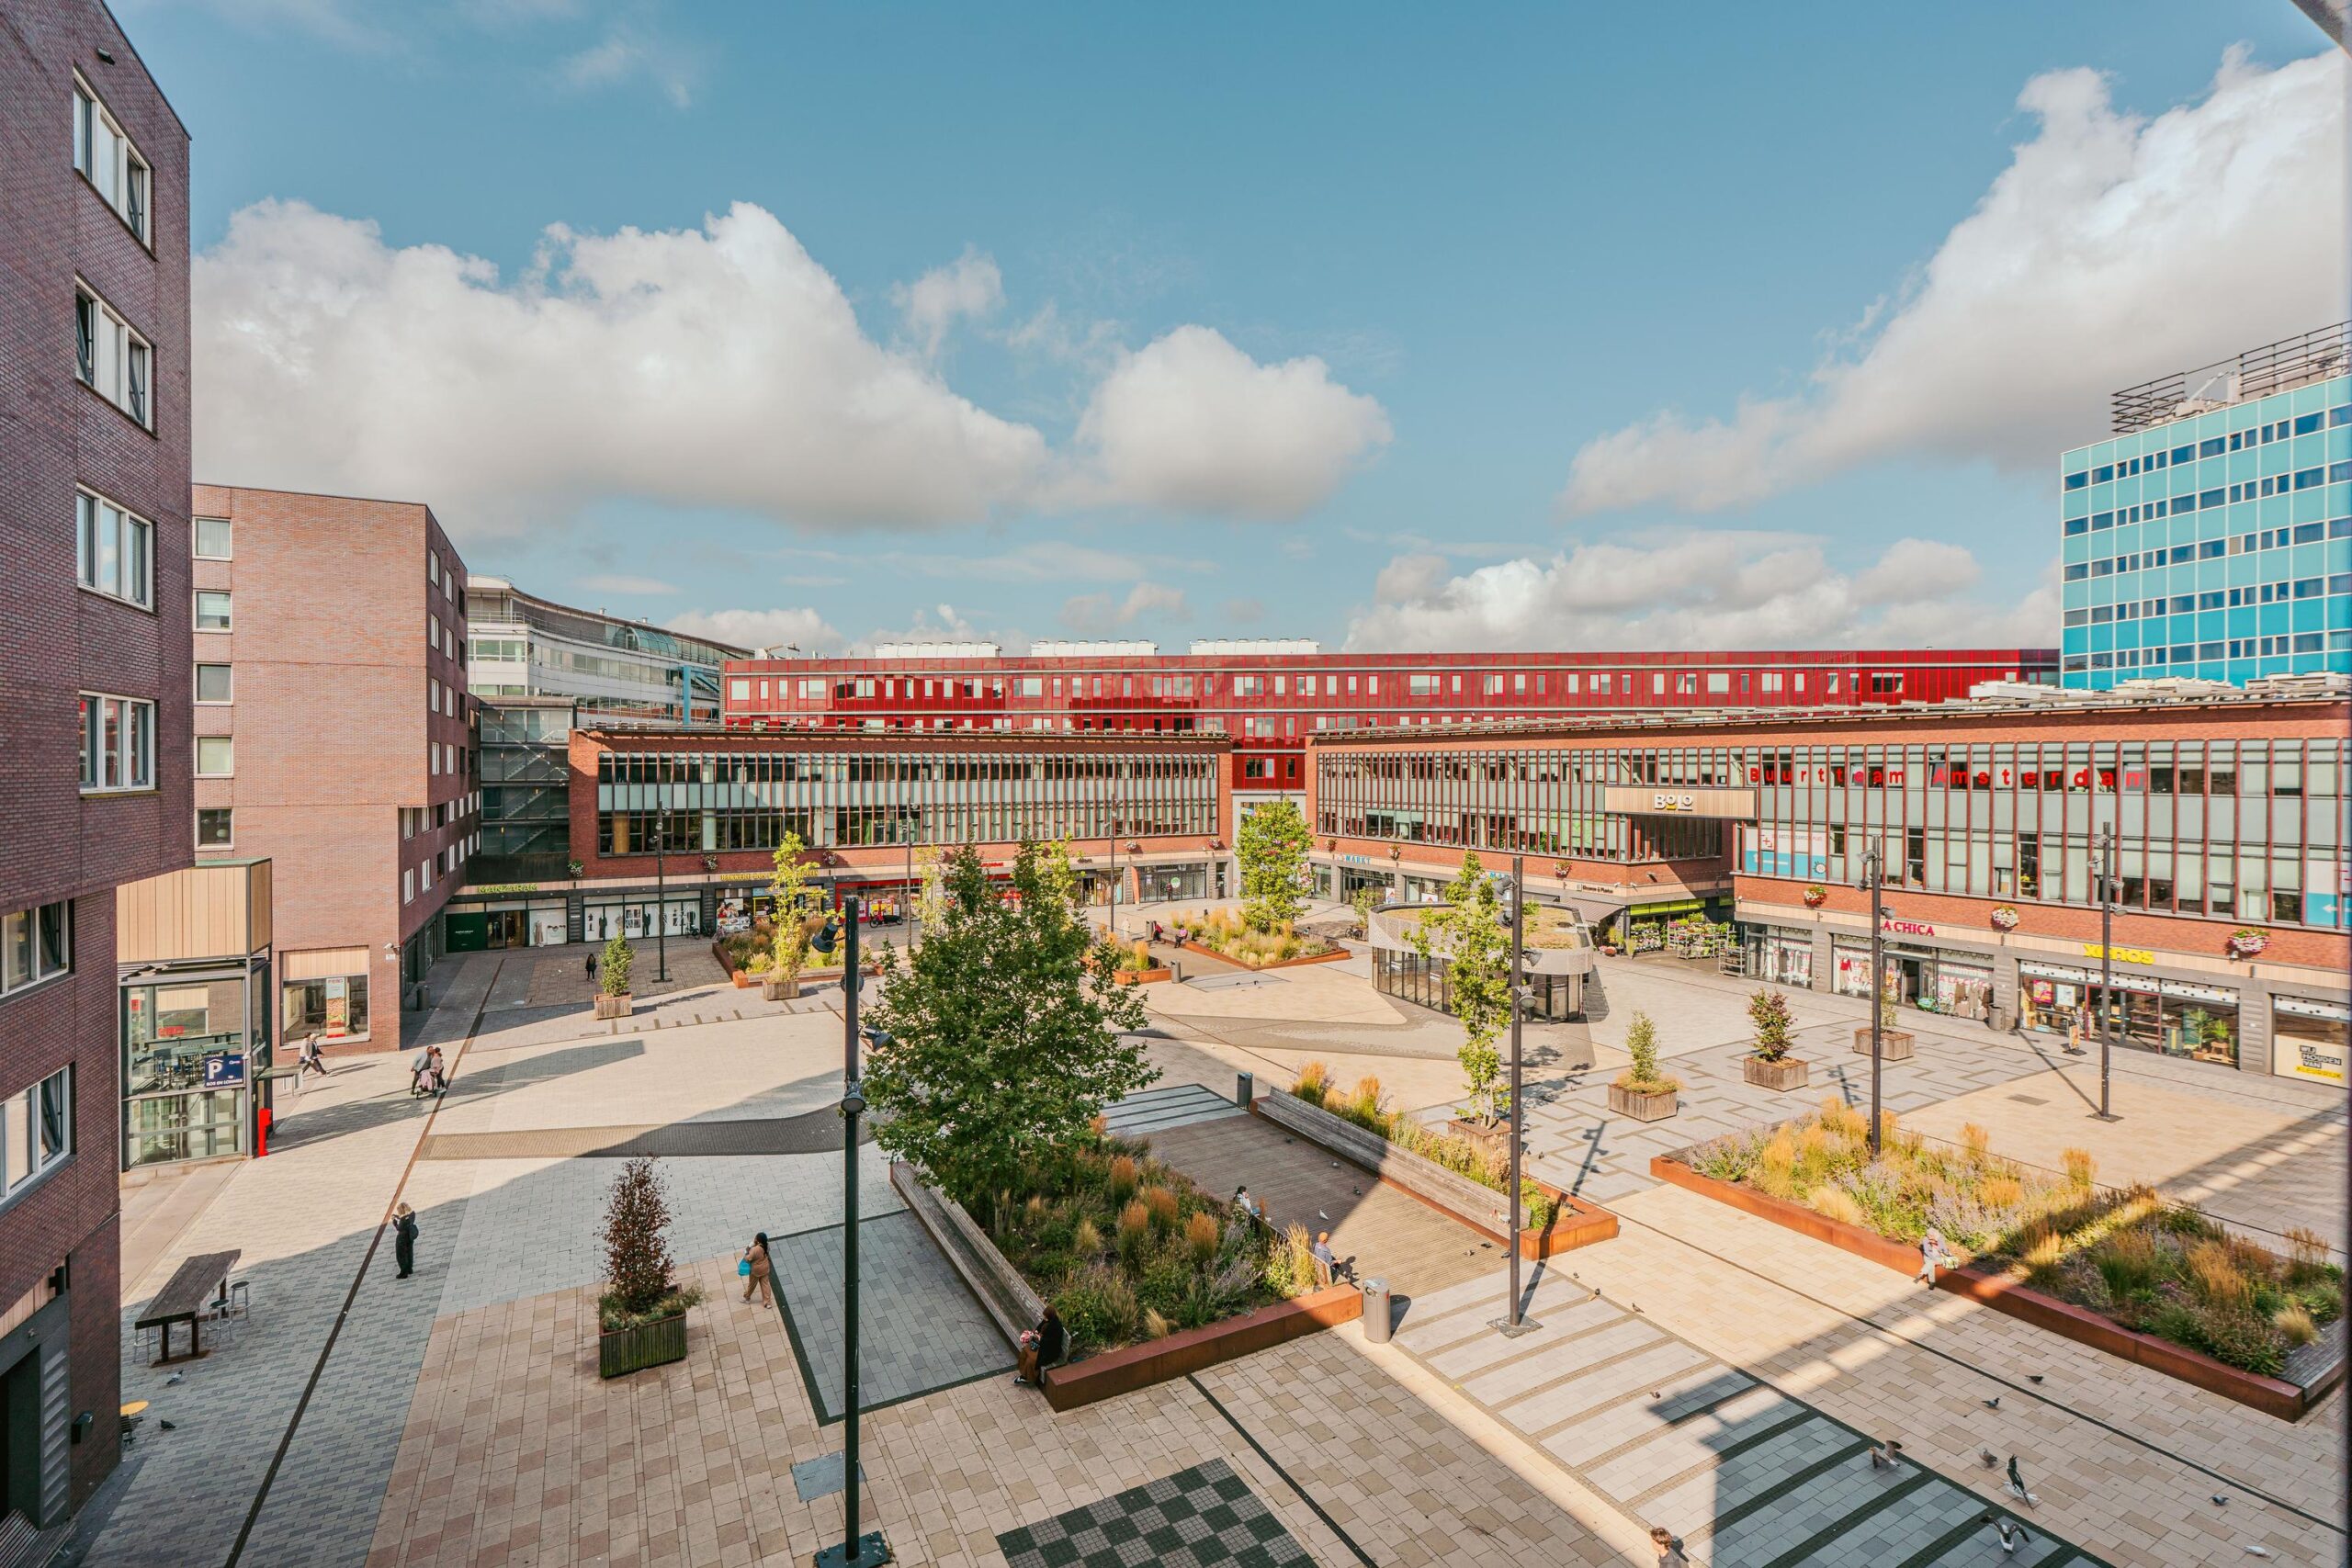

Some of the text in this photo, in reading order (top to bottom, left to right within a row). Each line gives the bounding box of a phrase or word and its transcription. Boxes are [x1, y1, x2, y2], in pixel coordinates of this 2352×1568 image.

[1749, 767, 2145, 787] Buurtteam Amsterdam
[1346, 854, 1371, 866] MARKT
[1894, 921, 1935, 937] CHICA
[208, 1062, 222, 1079] P
